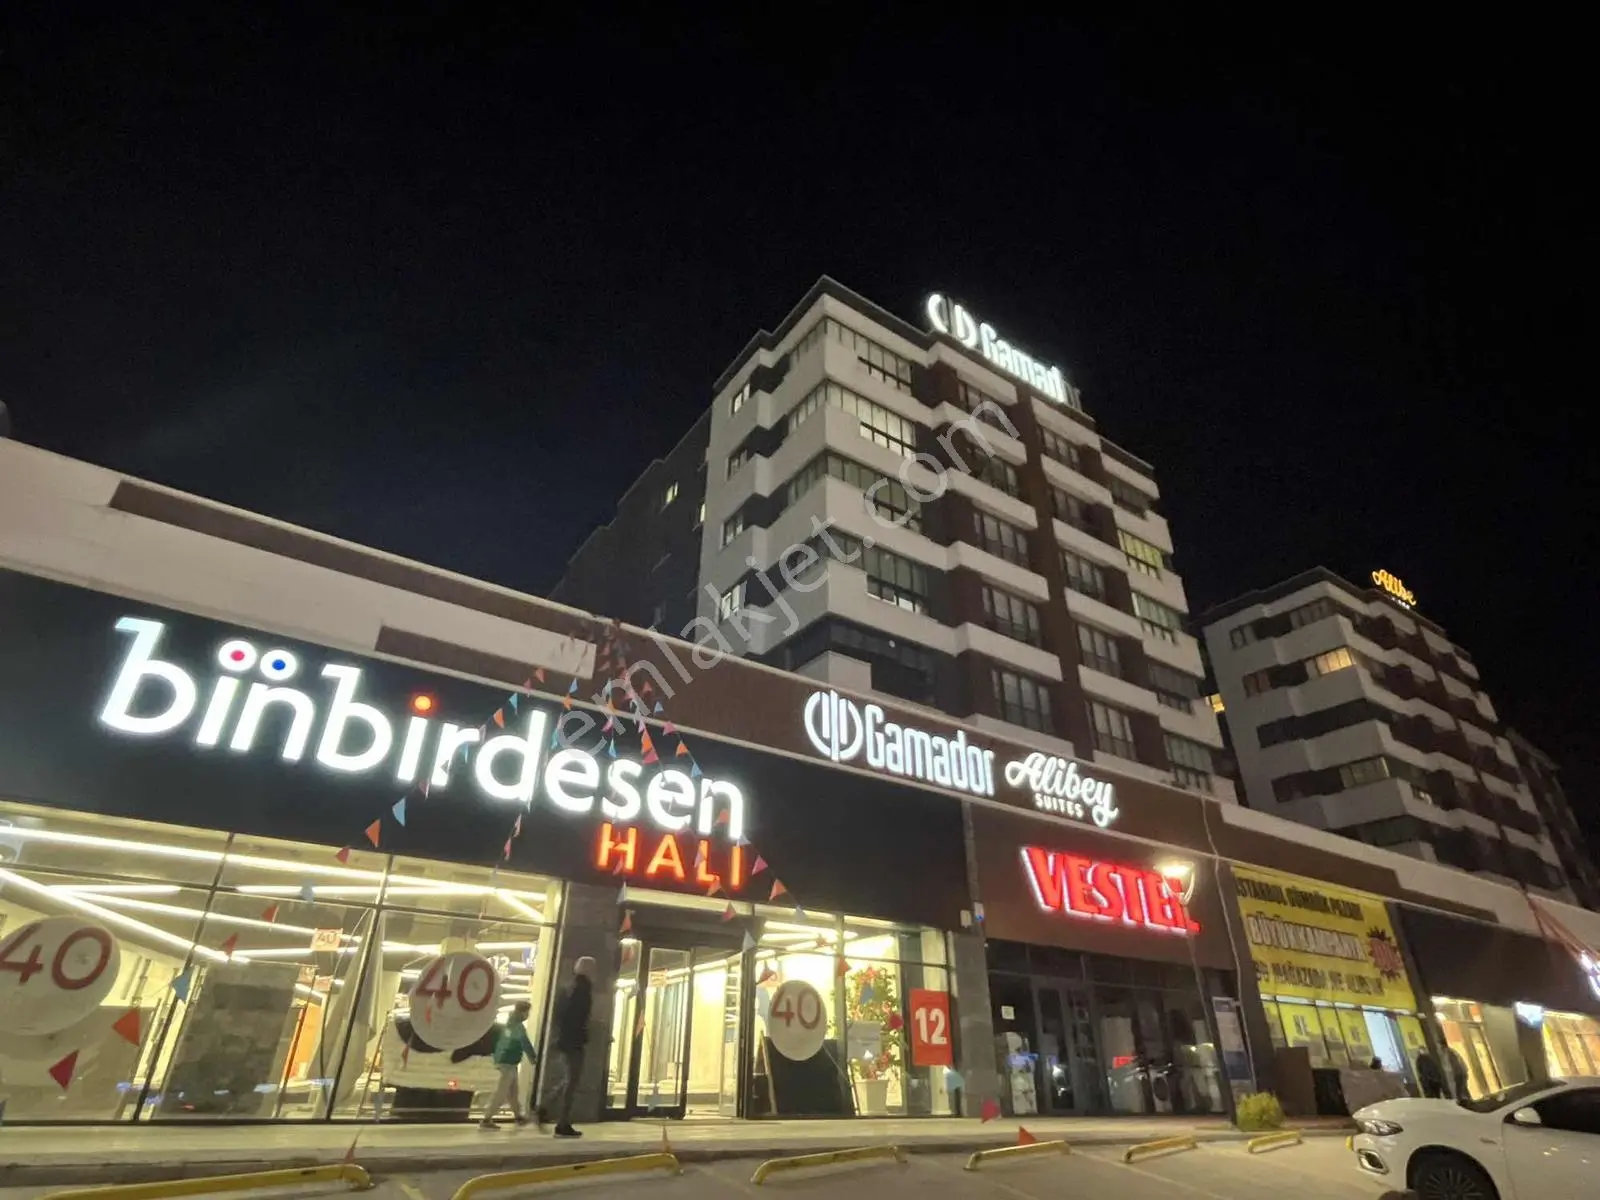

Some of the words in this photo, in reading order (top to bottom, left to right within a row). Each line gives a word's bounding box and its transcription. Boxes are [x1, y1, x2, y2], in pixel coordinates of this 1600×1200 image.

[98, 616, 746, 840] binbirdesen
[863, 704, 995, 797] Gamador
[1004, 752, 1119, 827] Alibey
[1035, 792, 1084, 818] SUITES
[597, 821, 742, 890] HALI
[1021, 846, 1201, 934] VESTEL
[0, 922, 113, 990] 40
[415, 957, 495, 1012] 40
[770, 988, 822, 1030] 40
[915, 1007, 948, 1045] 12
